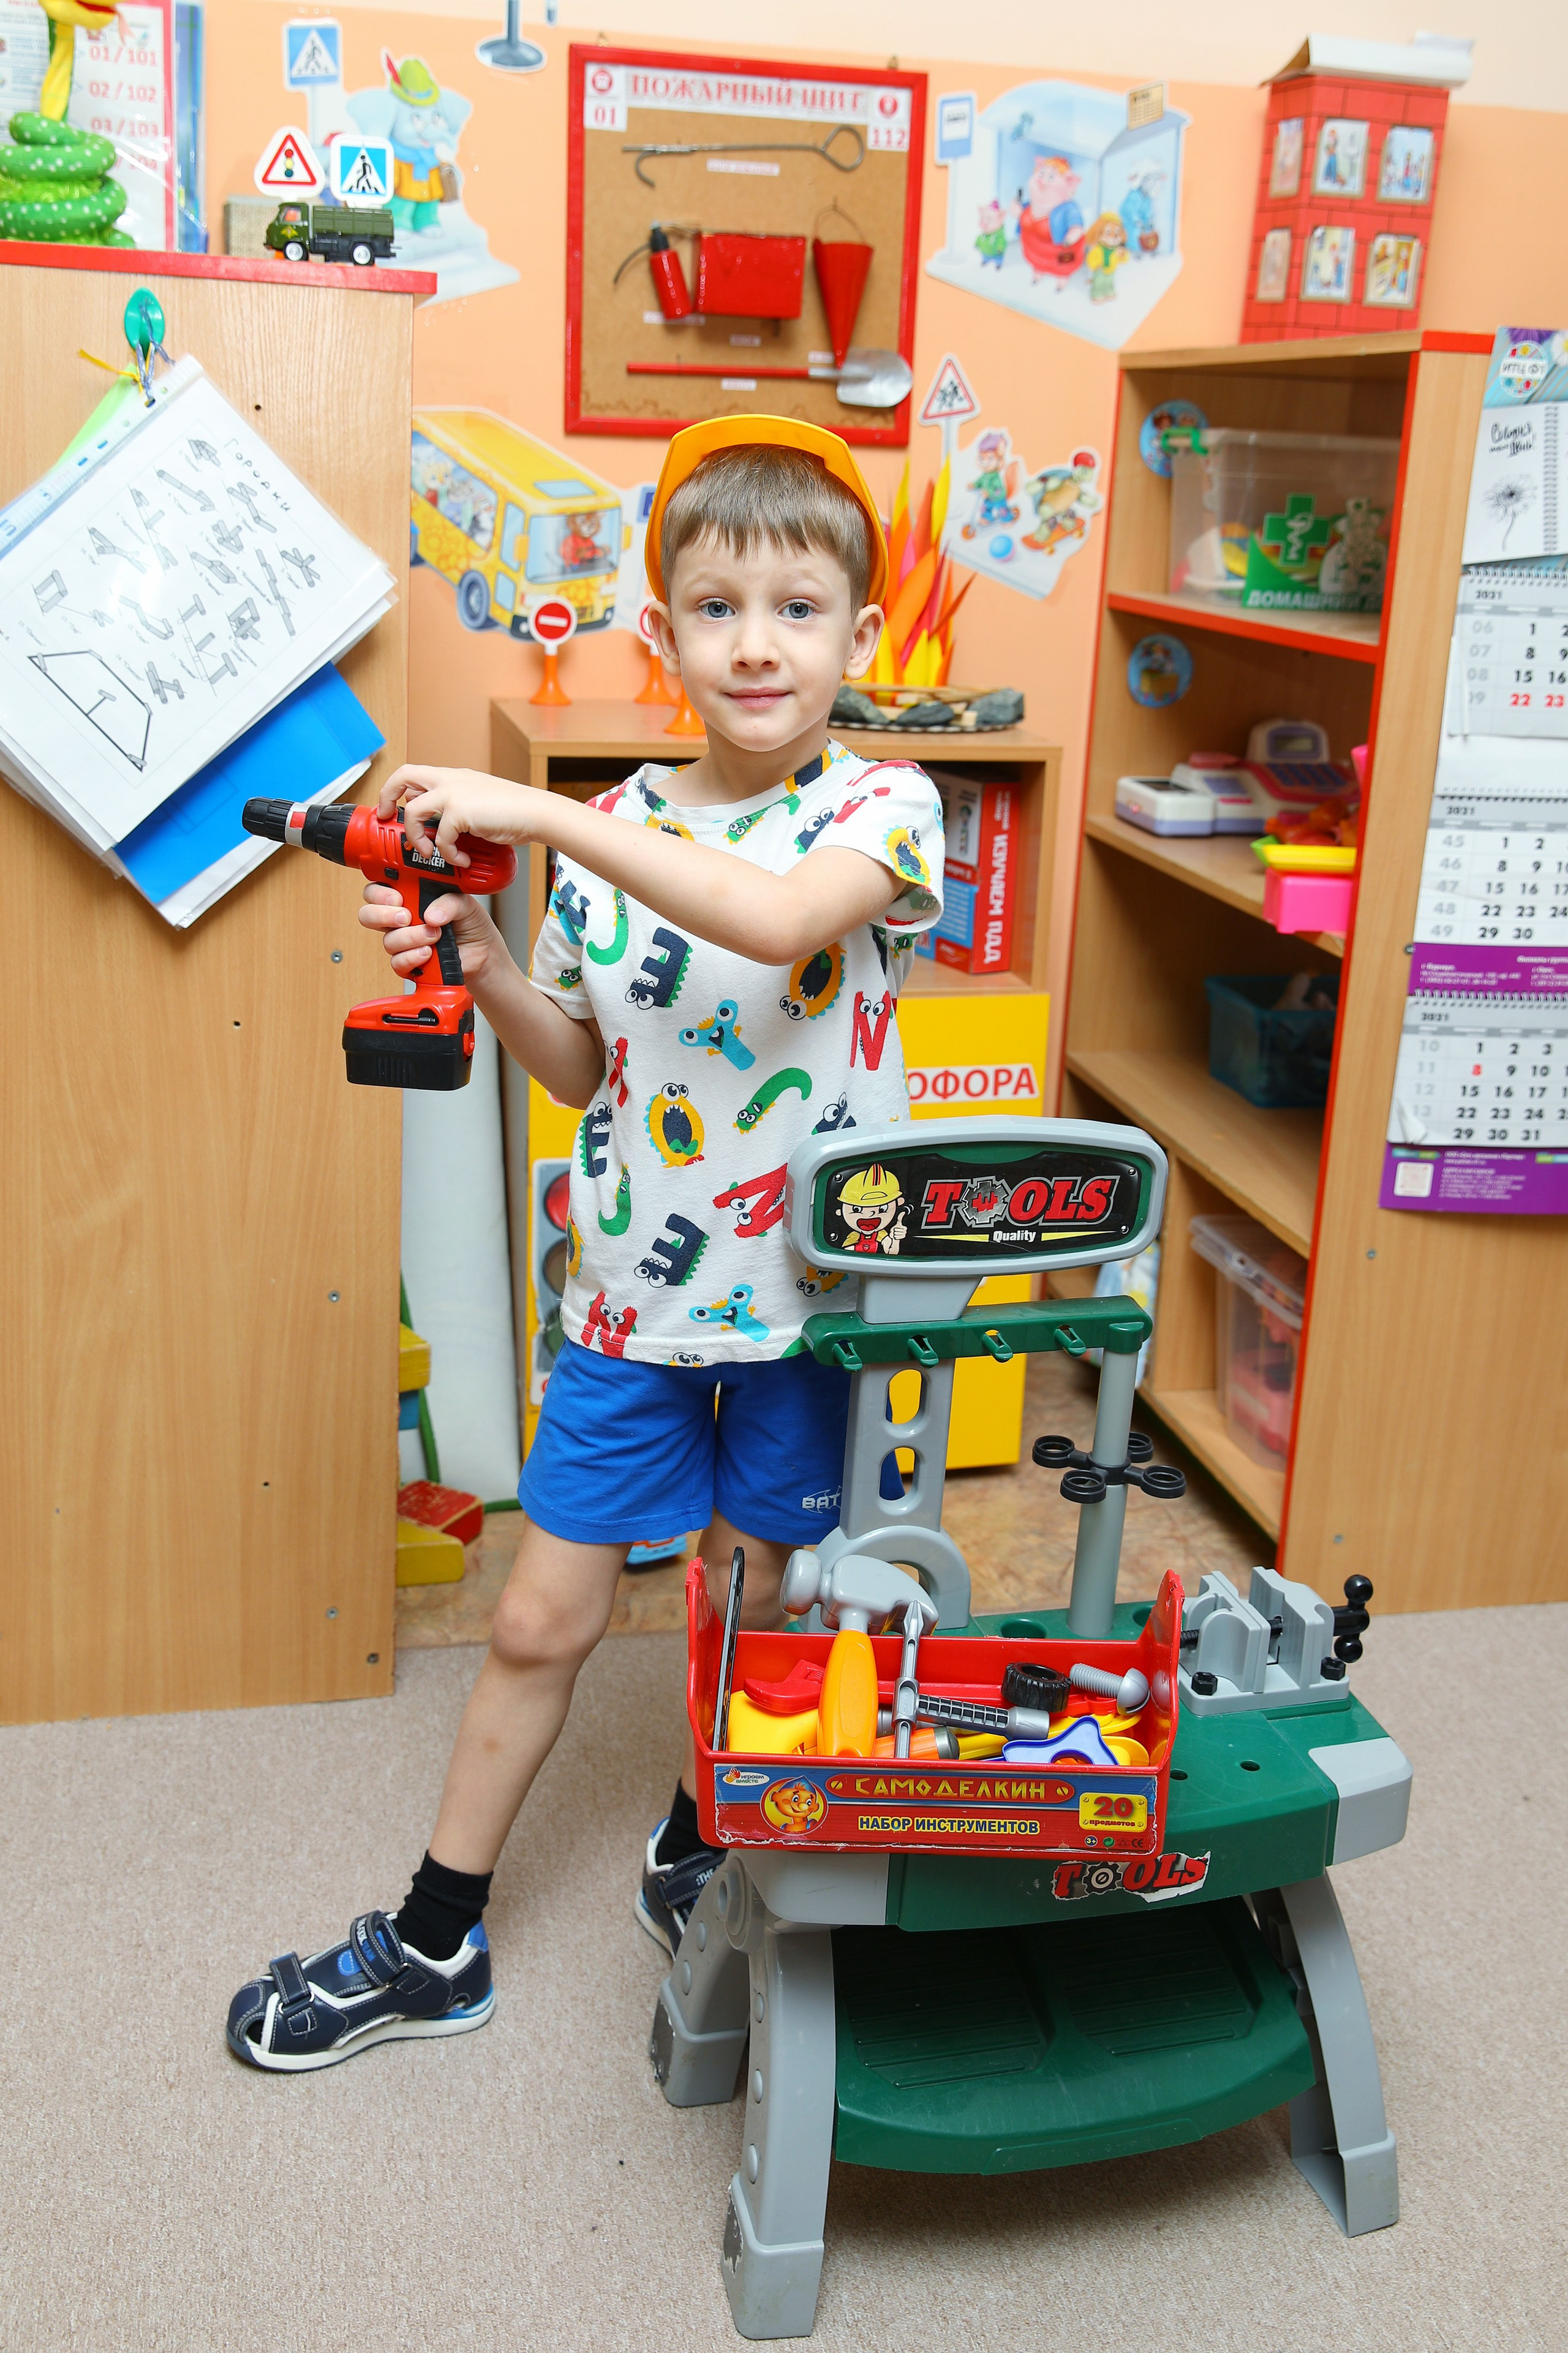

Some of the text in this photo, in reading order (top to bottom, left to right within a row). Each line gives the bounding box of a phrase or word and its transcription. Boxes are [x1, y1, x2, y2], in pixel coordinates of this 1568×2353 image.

[632, 74, 865, 111] ПОЖАРНЫЙ ЩИТ
[594, 106, 617, 128] 01
[873, 128, 906, 148] 112
[1475, 590, 1502, 600] 2021
[1529, 623, 1536, 636] 1
[1526, 648, 1534, 659] 8
[1515, 670, 1532, 683] 15
[1548, 671, 1567, 684] 16
[1510, 693, 1531, 706] 22
[1545, 695, 1564, 708] 23
[1447, 806, 1474, 815] 2021
[1504, 837, 1509, 849] 1
[1536, 838, 1544, 850] 2
[412, 852, 445, 868] DECKER
[1498, 860, 1506, 872] 8
[1532, 861, 1541, 873] 9
[1487, 882, 1504, 894] 15
[1521, 883, 1538, 894] 16
[984, 834, 1008, 964] ИЗУЧАЕМ ПДД
[1482, 905, 1501, 916] 22
[1516, 905, 1535, 917] 23
[1550, 906, 1568, 918] 24
[1479, 927, 1498, 939] 29
[1512, 927, 1533, 939] 30
[1422, 1013, 1449, 1021] 2021
[1477, 1042, 1482, 1054] 1
[1510, 1043, 1518, 1055] 2
[1542, 1044, 1551, 1055] 3
[1472, 1063, 1482, 1076] 8
[1507, 1065, 1516, 1076] 9
[1531, 1065, 1550, 1077] 10
[1461, 1086, 1479, 1097] 15
[1495, 1086, 1513, 1097] 16
[1529, 1087, 1547, 1098] 17
[1457, 1108, 1476, 1119] 22
[1491, 1108, 1510, 1119] 23
[1525, 1109, 1544, 1120] 24
[1454, 1128, 1539, 1141] 29 30 31
[992, 1229, 1037, 1242] Quality
[855, 1777, 1045, 1800] САМОДЕЛКИН
[1093, 1796, 1134, 1818] 20
[859, 1817, 1039, 1834] НАБОР ИНСТРУМЕНТОВ
[1089, 1819, 1136, 1827] предметов
